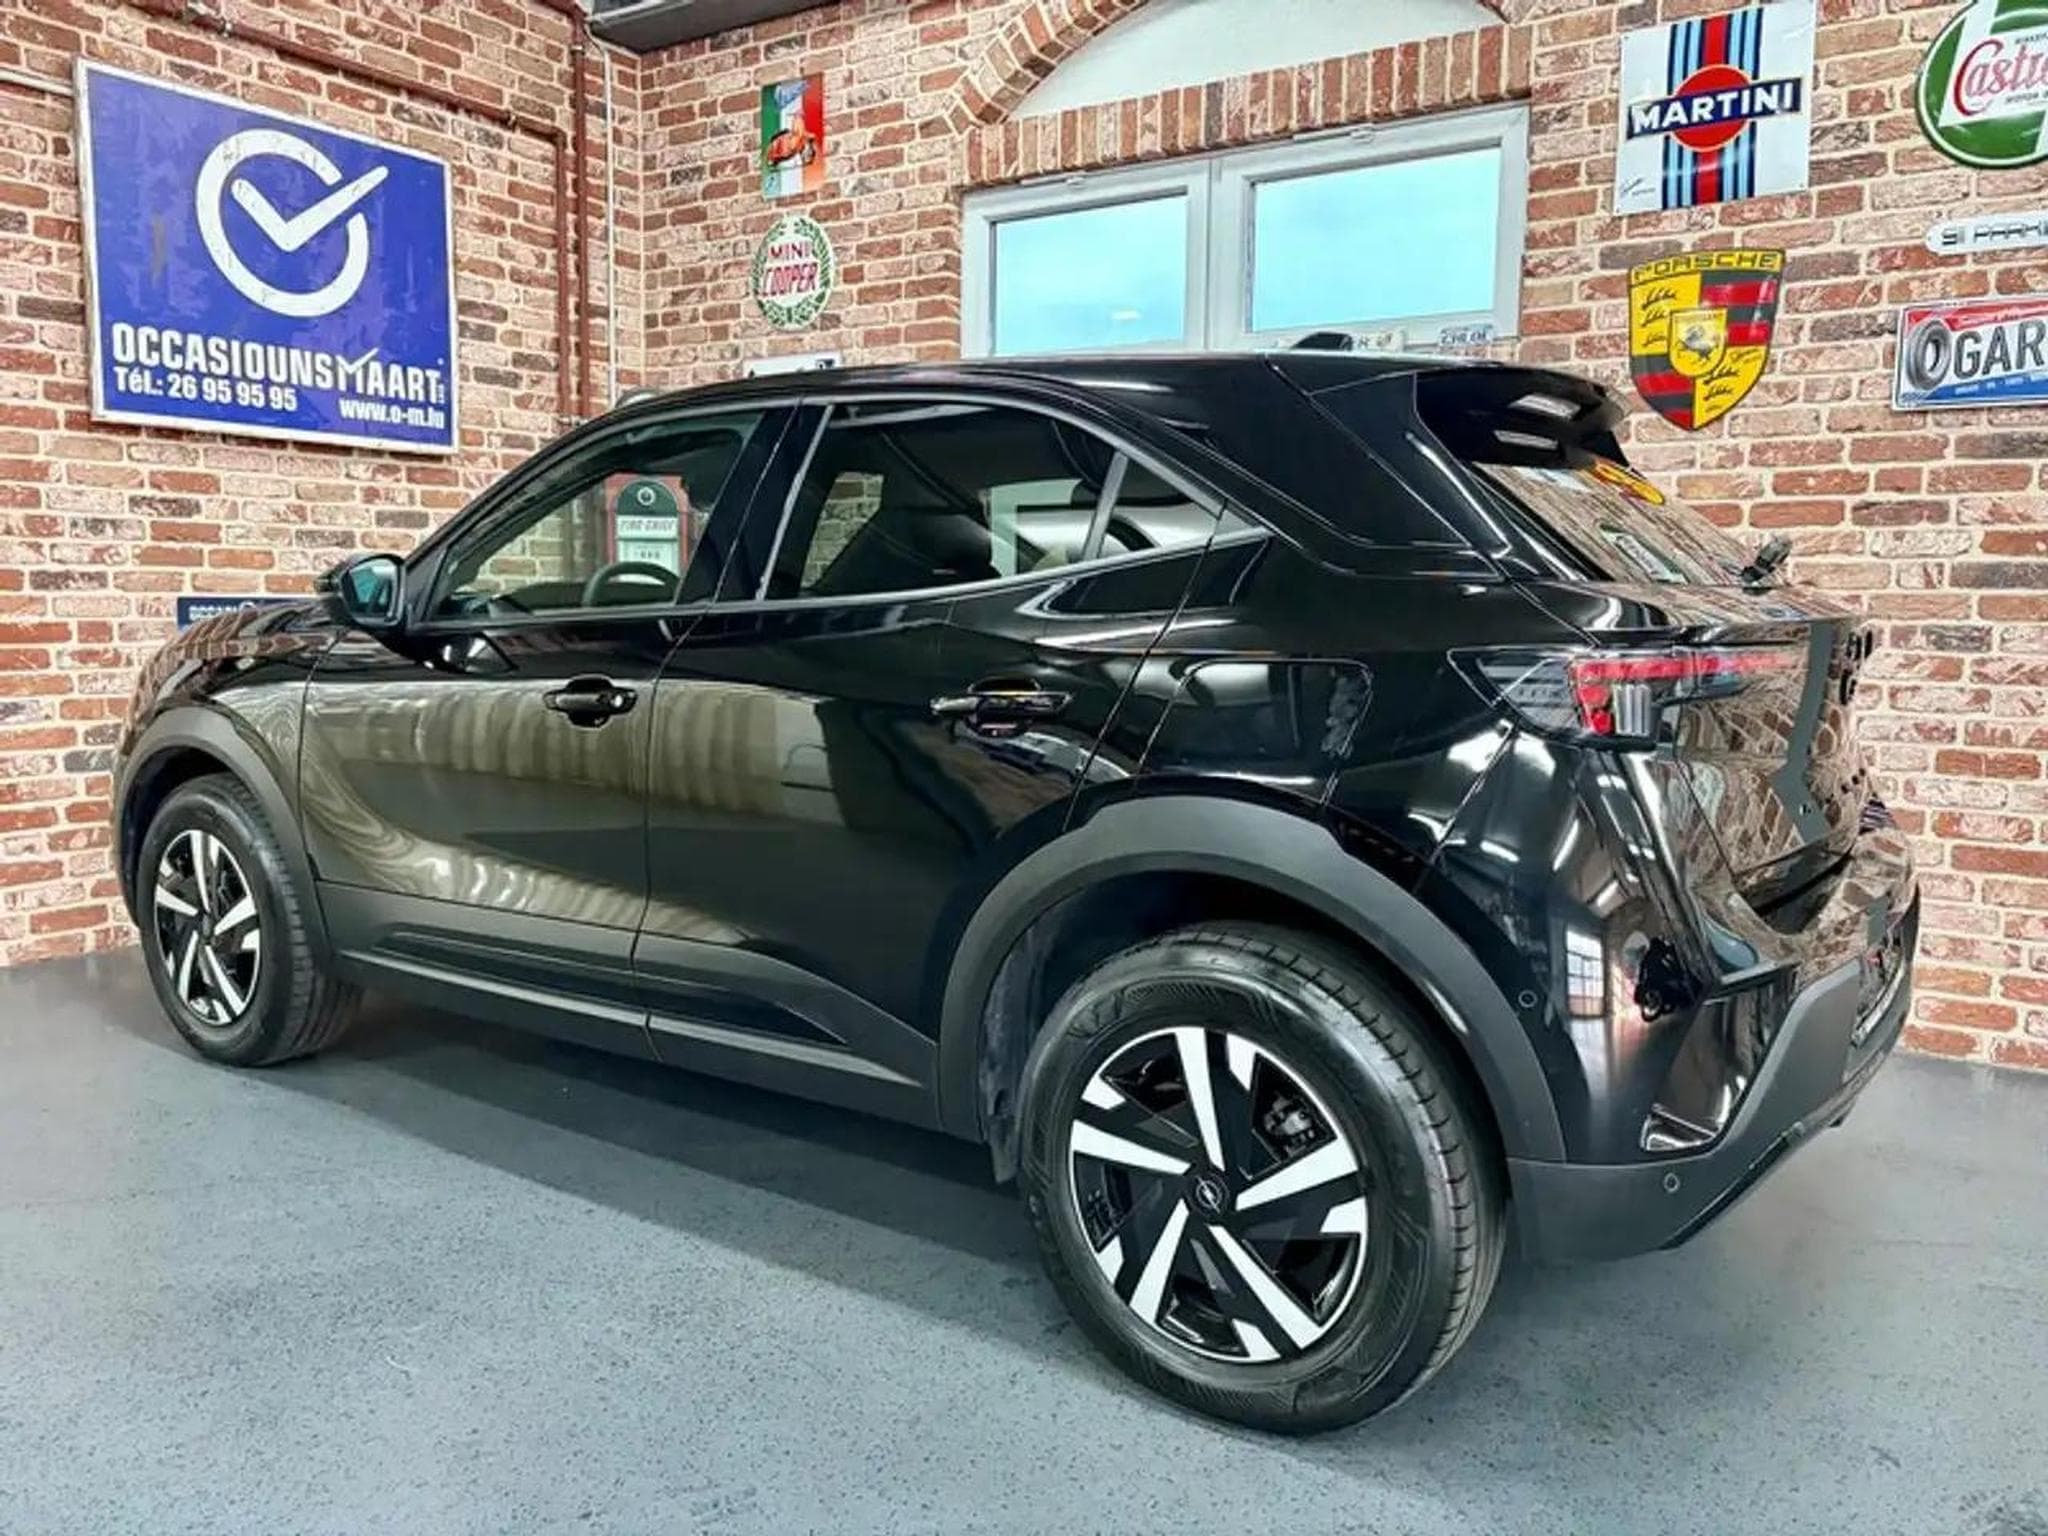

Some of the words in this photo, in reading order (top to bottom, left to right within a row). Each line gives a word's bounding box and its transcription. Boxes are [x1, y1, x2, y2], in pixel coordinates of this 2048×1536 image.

[1631, 83, 1793, 134] MARTINI
[770, 241, 811, 259] MINI
[1634, 252, 1778, 281] PORSCHE
[761, 262, 819, 297] COOPER
[167, 371, 197, 400] 26
[201, 377, 232, 406] 95
[236, 381, 267, 410] 95
[269, 386, 298, 412] 95
[338, 397, 445, 430] www.o-m.lu
